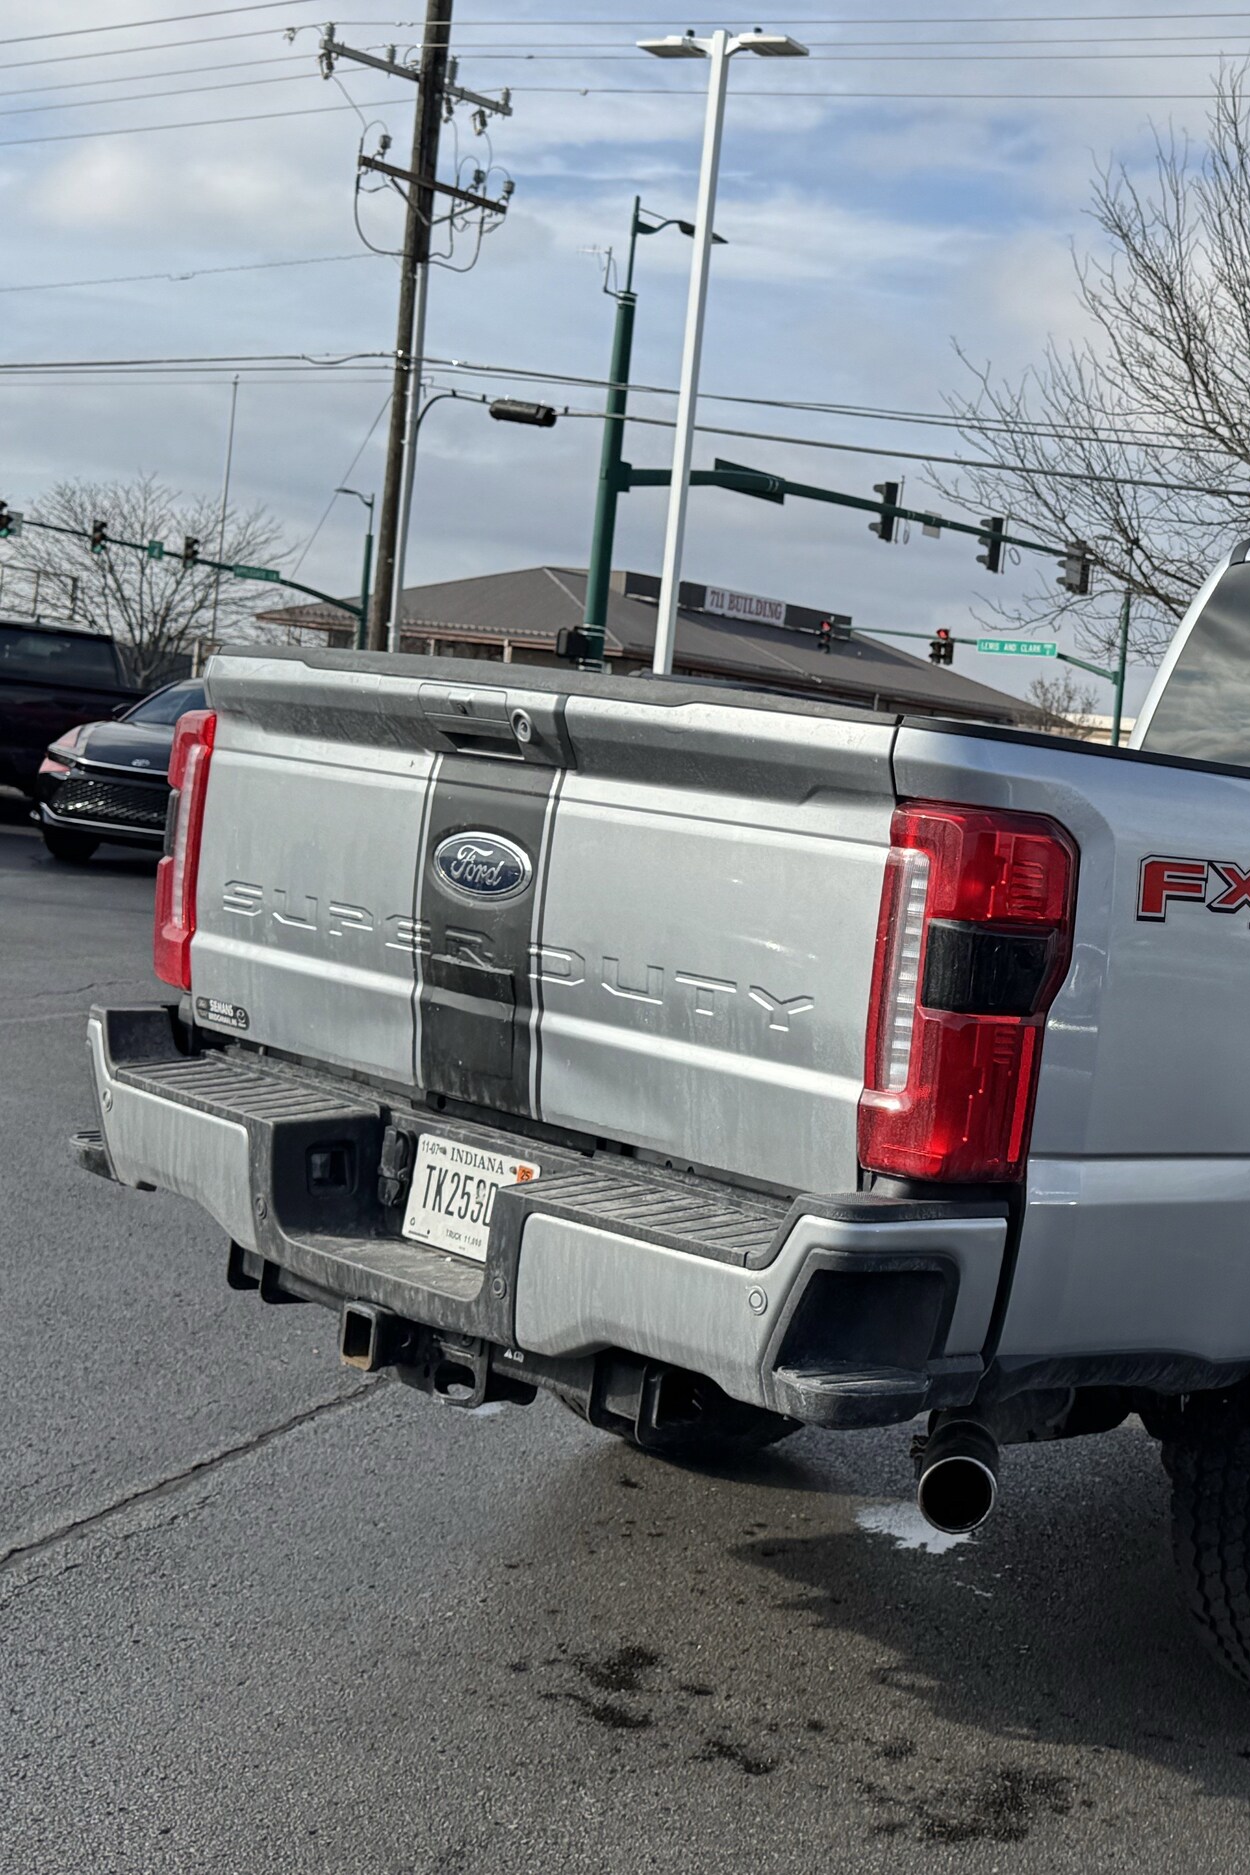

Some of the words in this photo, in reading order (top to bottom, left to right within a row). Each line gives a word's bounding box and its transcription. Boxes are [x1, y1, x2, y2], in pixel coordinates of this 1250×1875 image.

[710, 590, 725, 609] 711
[727, 593, 783, 620] BUILDING
[981, 642, 1000, 651] LEWIS
[1003, 643, 1017, 652] AND
[1020, 644, 1042, 653] CLARK
[451, 845, 505, 886] Ford
[222, 879, 495, 969] SUPER
[527, 941, 815, 1032] DUTY
[450, 1147, 505, 1175] INDIANA
[520, 1170, 531, 1181] 25
